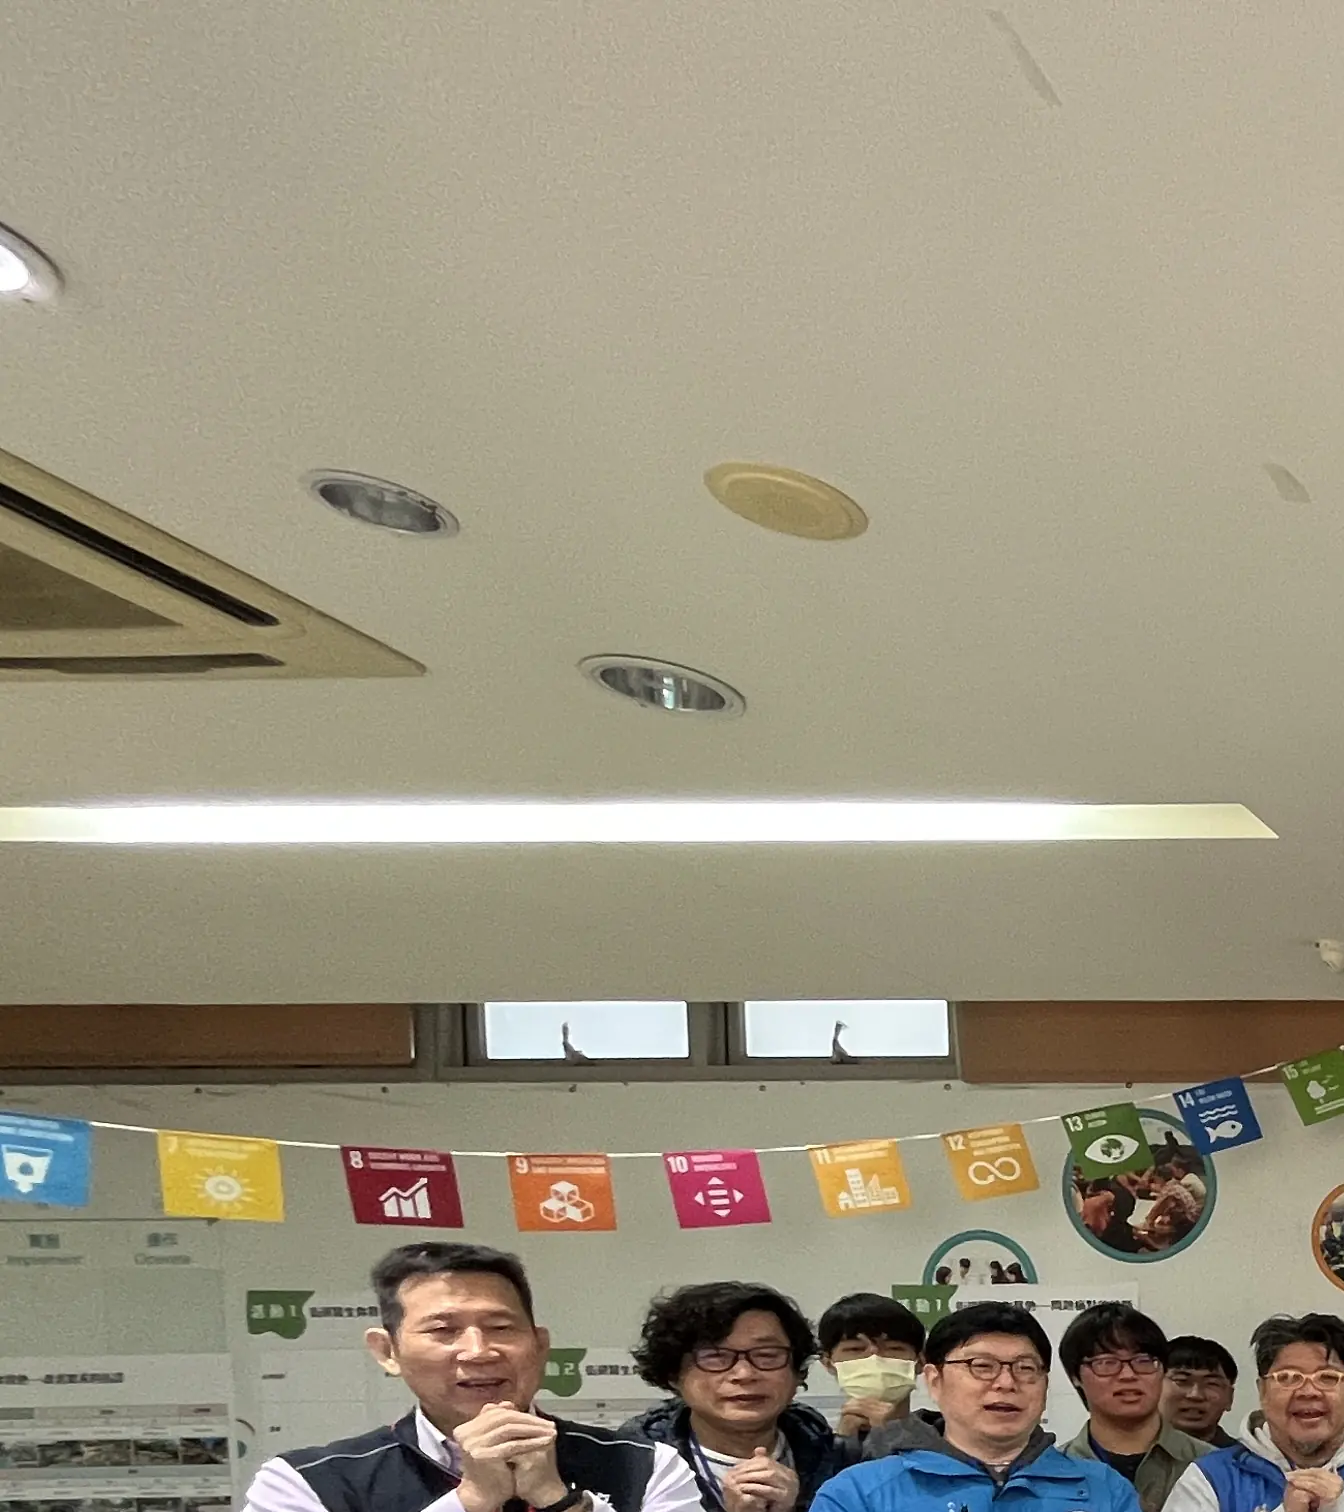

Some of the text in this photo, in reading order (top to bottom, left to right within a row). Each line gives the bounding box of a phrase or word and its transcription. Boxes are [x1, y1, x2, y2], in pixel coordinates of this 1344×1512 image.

[1283, 1064, 1299, 1080] 15
[1178, 1090, 1195, 1109] 14
[1066, 1115, 1084, 1132] 13
[946, 1133, 966, 1151] 12
[349, 1150, 364, 1169] 8
[515, 1156, 529, 1174] 9
[667, 1156, 689, 1174] 10
